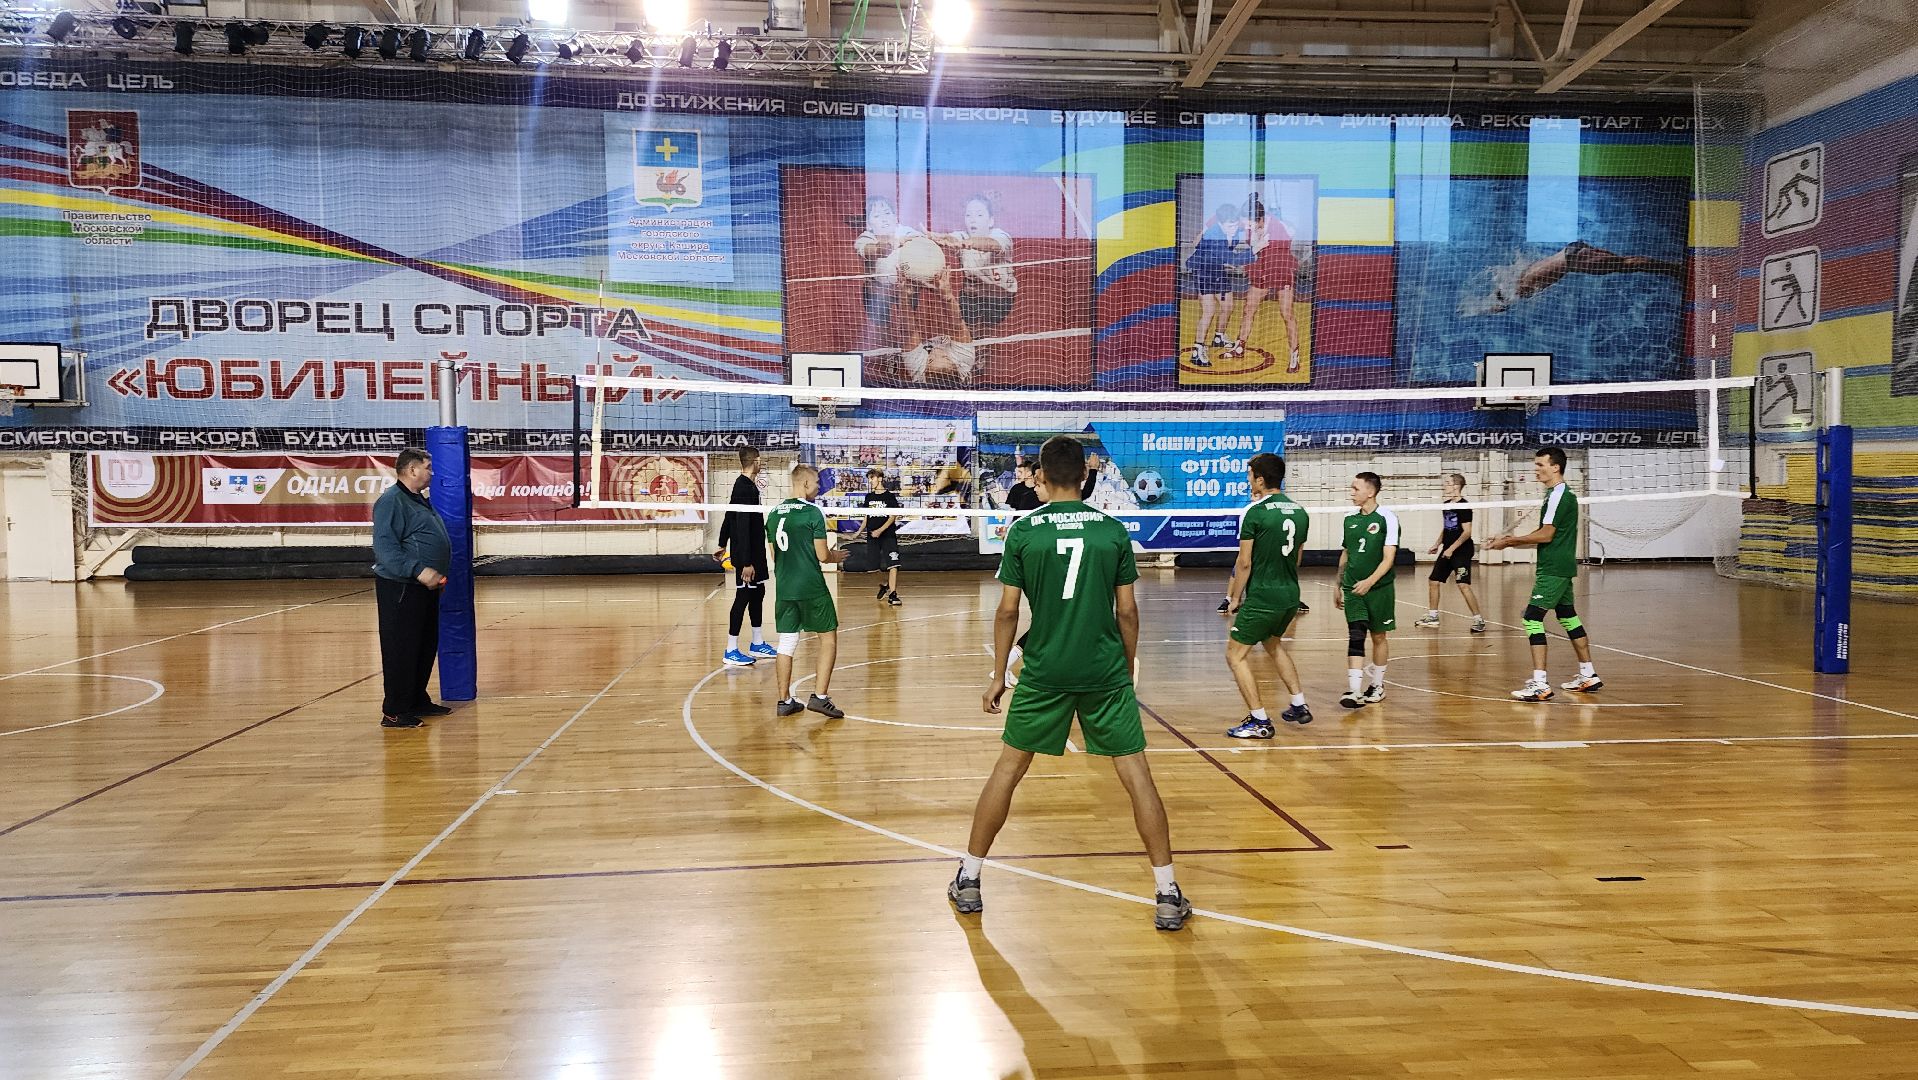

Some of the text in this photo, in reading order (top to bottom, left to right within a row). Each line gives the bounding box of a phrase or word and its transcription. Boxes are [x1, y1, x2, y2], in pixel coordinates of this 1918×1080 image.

[0, 71, 174, 91] ОБЕДА ЦЕЛЬ
[617, 92, 1725, 130] ДОСТИЖЕНИЯ СМЕЛОСТЬ РЕКОРД БУДУЩЕЕ СПОРТ СИЛА ДИНАМИКА РЕКОРД СТАРТ УСПЕХ
[62, 210, 152, 222] Правительство
[628, 217, 712, 228] Администрация
[73, 222, 142, 233] Московской
[85, 235, 132, 245] области
[617, 251, 680, 261] Московской
[146, 298, 651, 341] ДВОРЕЦ СПОРТА
[0, 431, 139, 445] СМЕЛОСТЬ
[160, 431, 259, 448] РЕКОРД
[284, 431, 406, 448] БУДУЩЕЕ
[467, 432, 508, 446] ОРТ
[612, 433, 749, 449] ДИНАМИКА
[1142, 433, 1264, 453] Каширскому
[1326, 433, 1394, 446] ПОЛЕТ
[1409, 432, 1524, 445] ГАРМОНИЯ
[1539, 431, 1641, 444] СКОРОСТЬ
[1181, 455, 1250, 476] футбол
[287, 475, 397, 496] ОДНА СТР
[473, 482, 506, 497] дна
[1186, 479, 1252, 496] 100 ле
[776, 517, 789, 552] 6
[1281, 518, 1296, 557] 3
[1357, 537, 1367, 553] 2
[1056, 537, 1085, 600] 7
